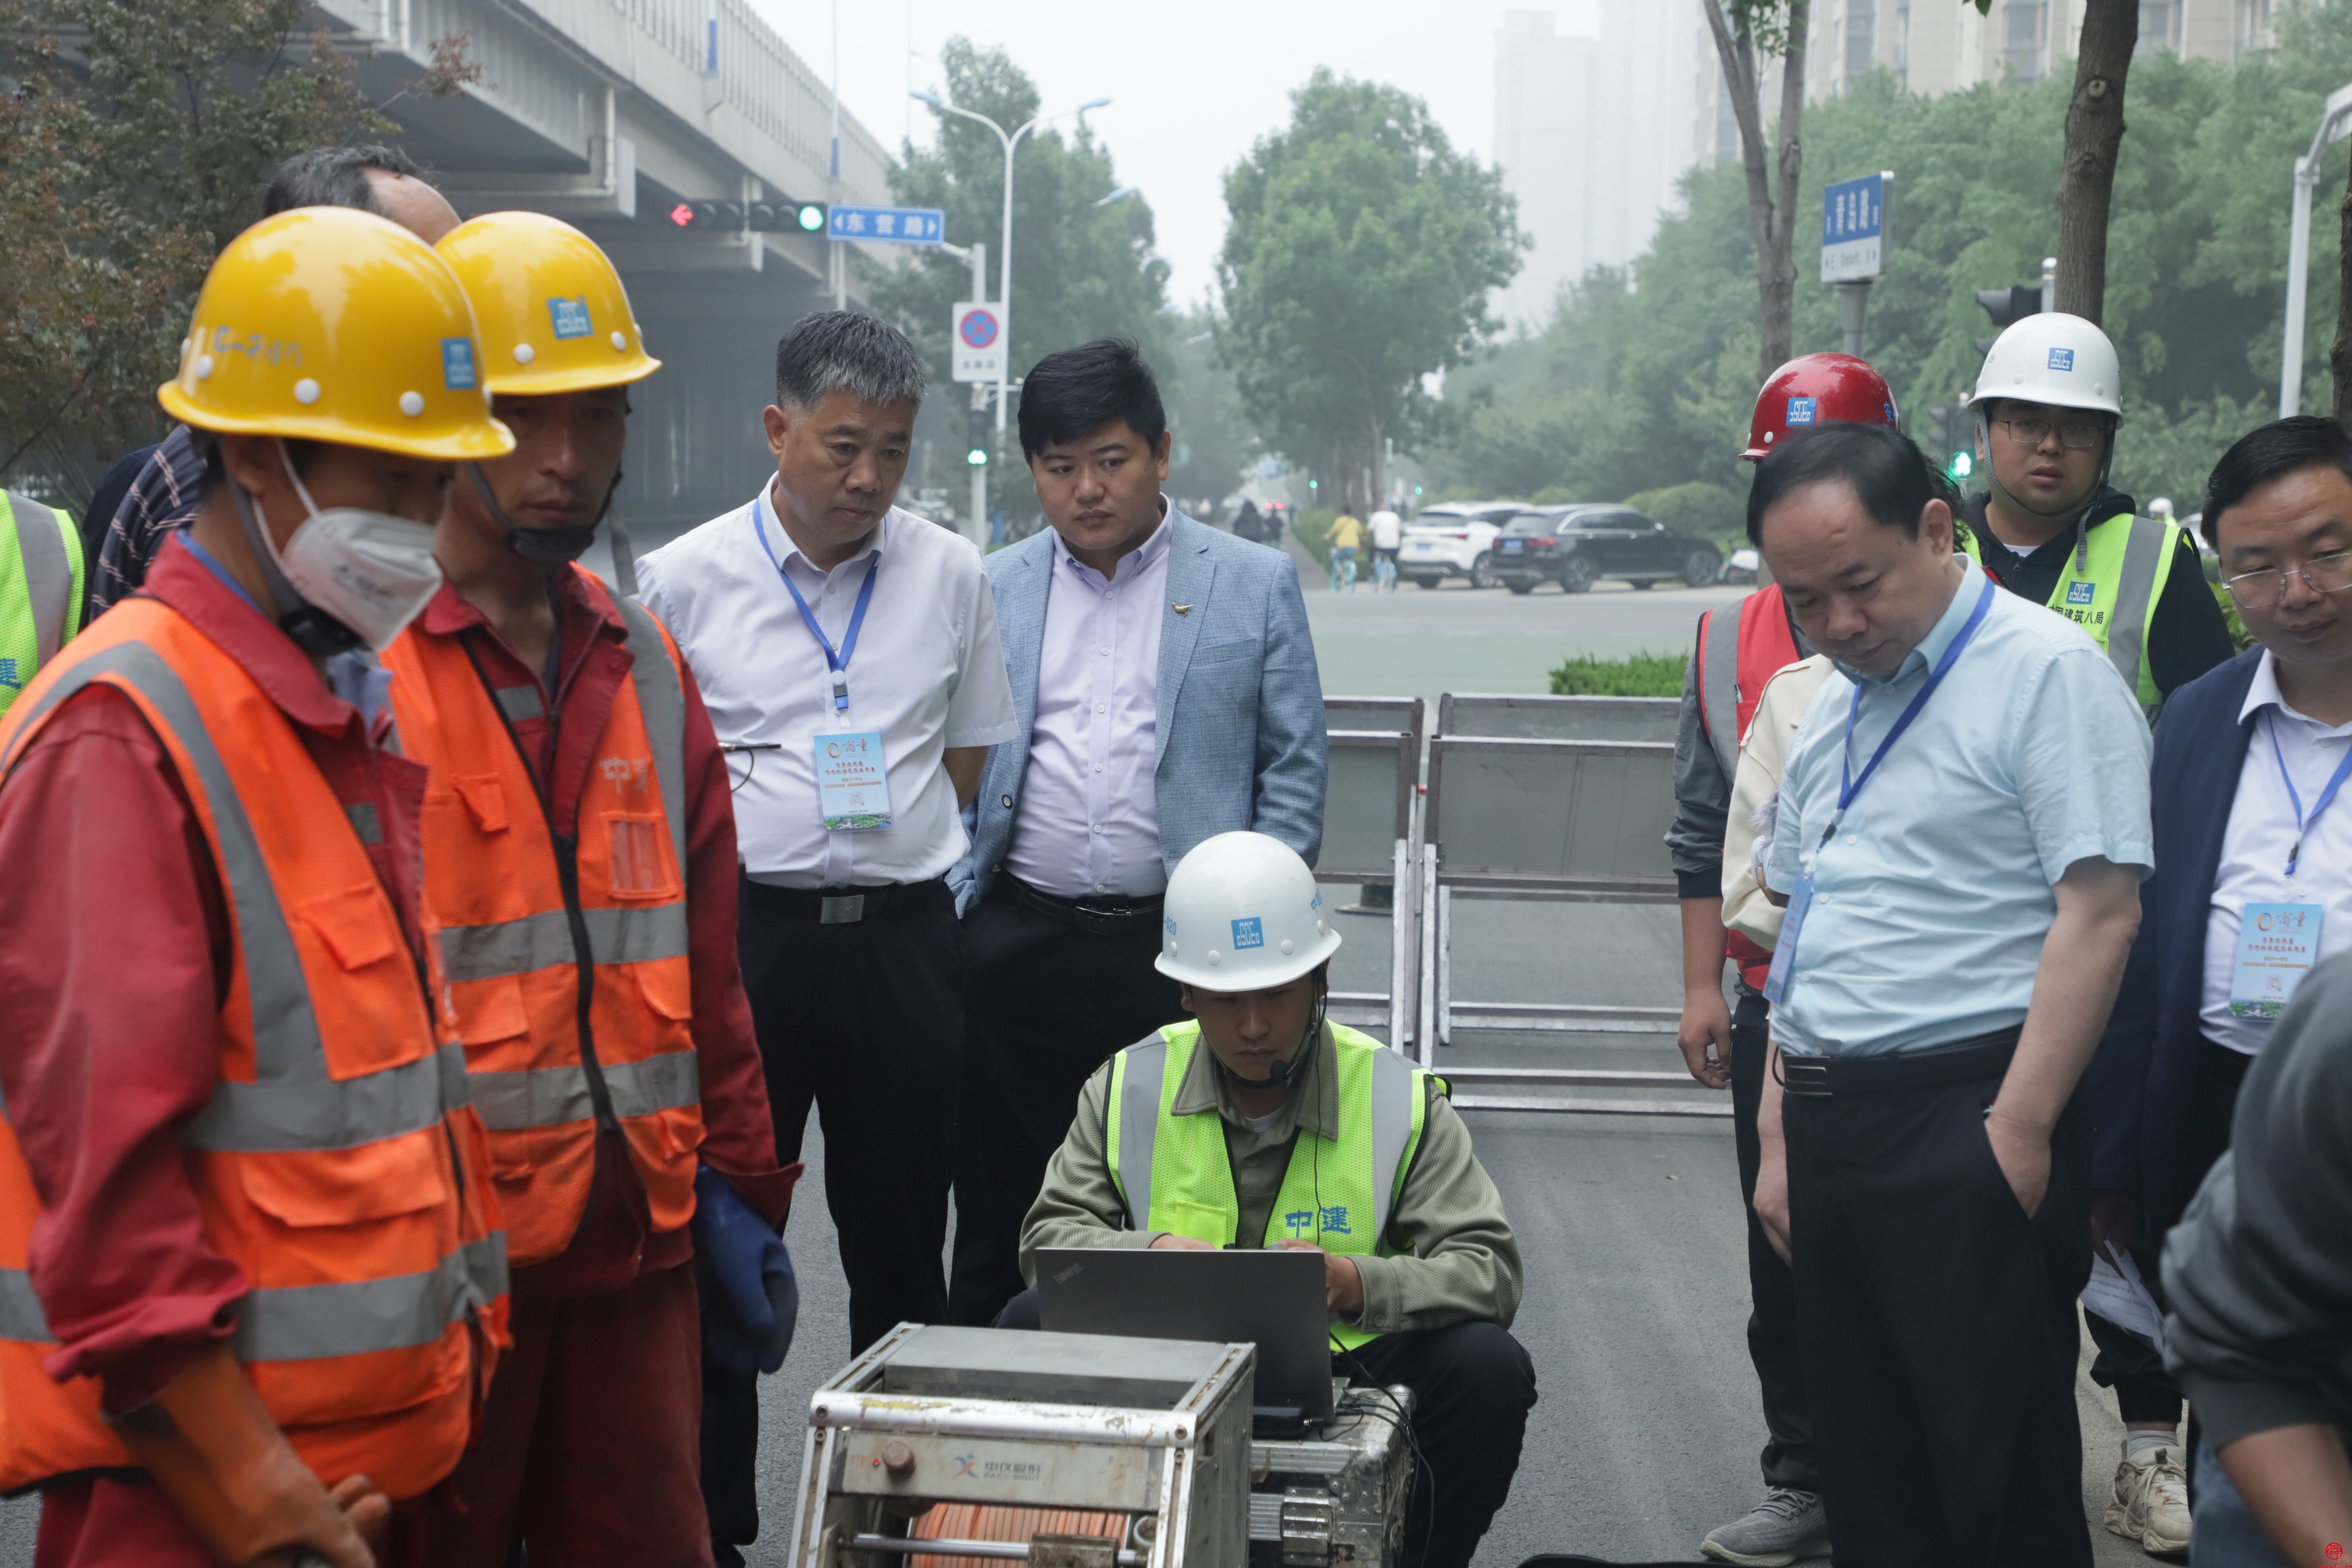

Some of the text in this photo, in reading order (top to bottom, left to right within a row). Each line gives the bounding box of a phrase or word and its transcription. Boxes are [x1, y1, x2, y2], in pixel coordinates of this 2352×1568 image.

[846, 212, 923, 237] 东营路
[1883, 401, 1897, 423] 安
[1285, 1205, 1352, 1238] 中建
[985, 1461, 1041, 1475] 中仪股份
